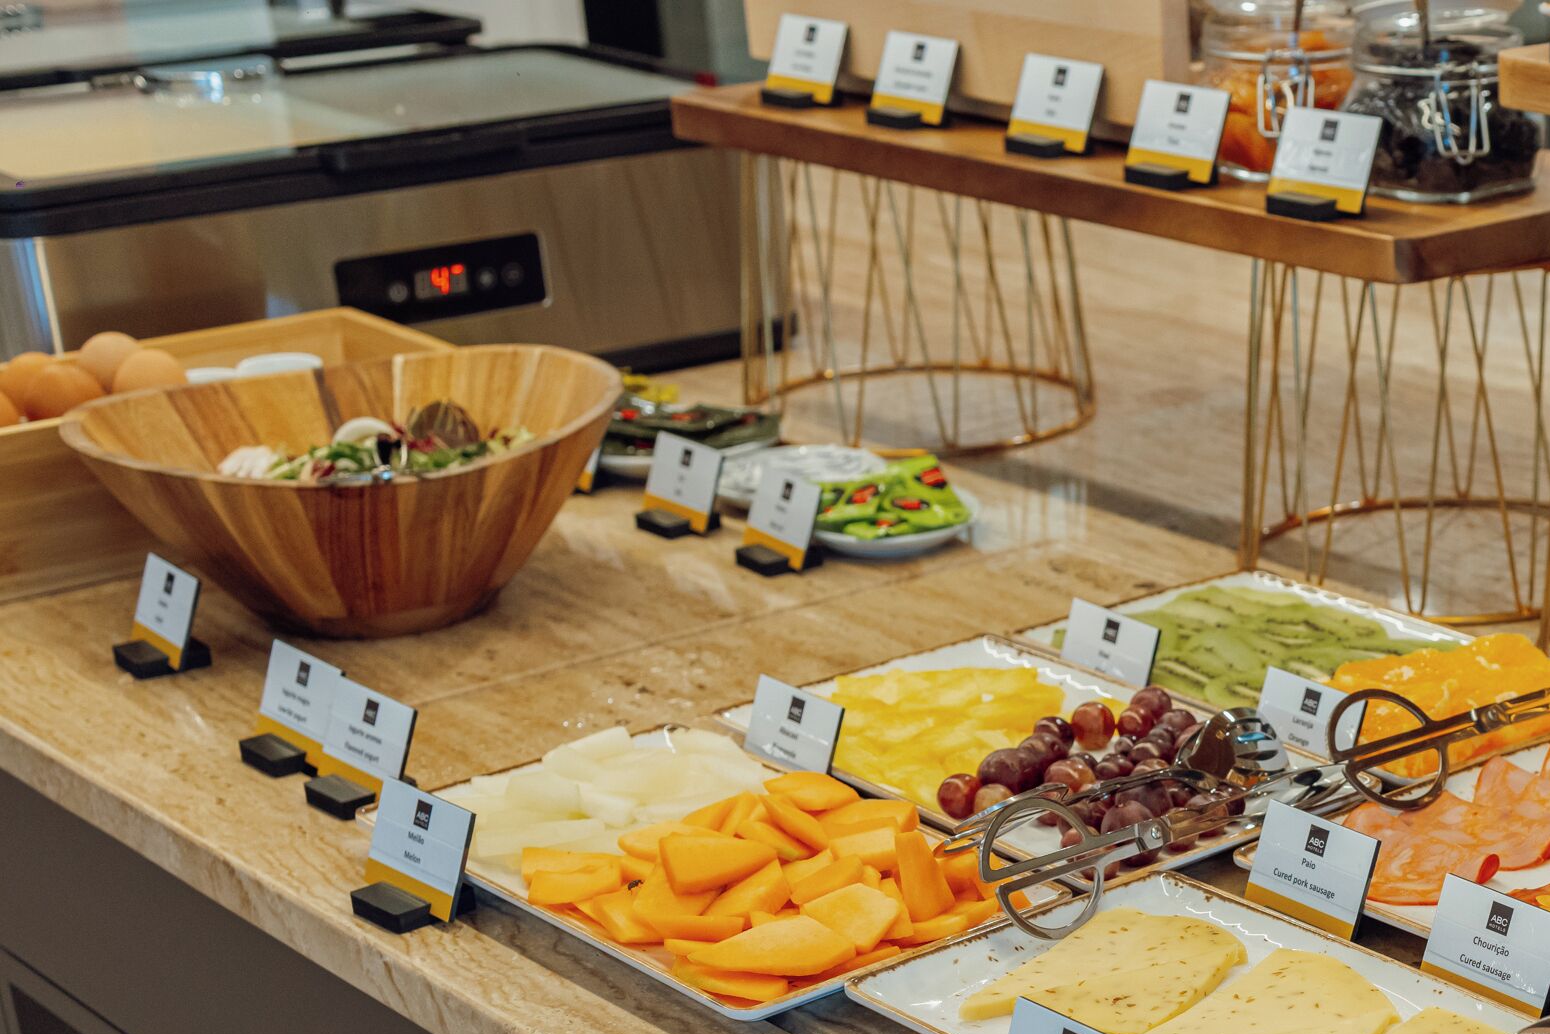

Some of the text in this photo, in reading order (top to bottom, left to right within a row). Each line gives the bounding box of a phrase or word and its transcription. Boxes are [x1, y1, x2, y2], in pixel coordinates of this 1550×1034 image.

[416, 811, 429, 822] ABC
[408, 831, 425, 845] Melão
[1308, 837, 1325, 849] ABC
[404, 850, 421, 864] Melon
[1301, 858, 1316, 870] Paio
[1273, 868, 1335, 899] Cured pork sausage
[1490, 914, 1508, 927] ABC
[1488, 923, 1506, 933] HOTELS
[1473, 936, 1509, 957] Chourição
[1459, 953, 1511, 981] Cured sausage
